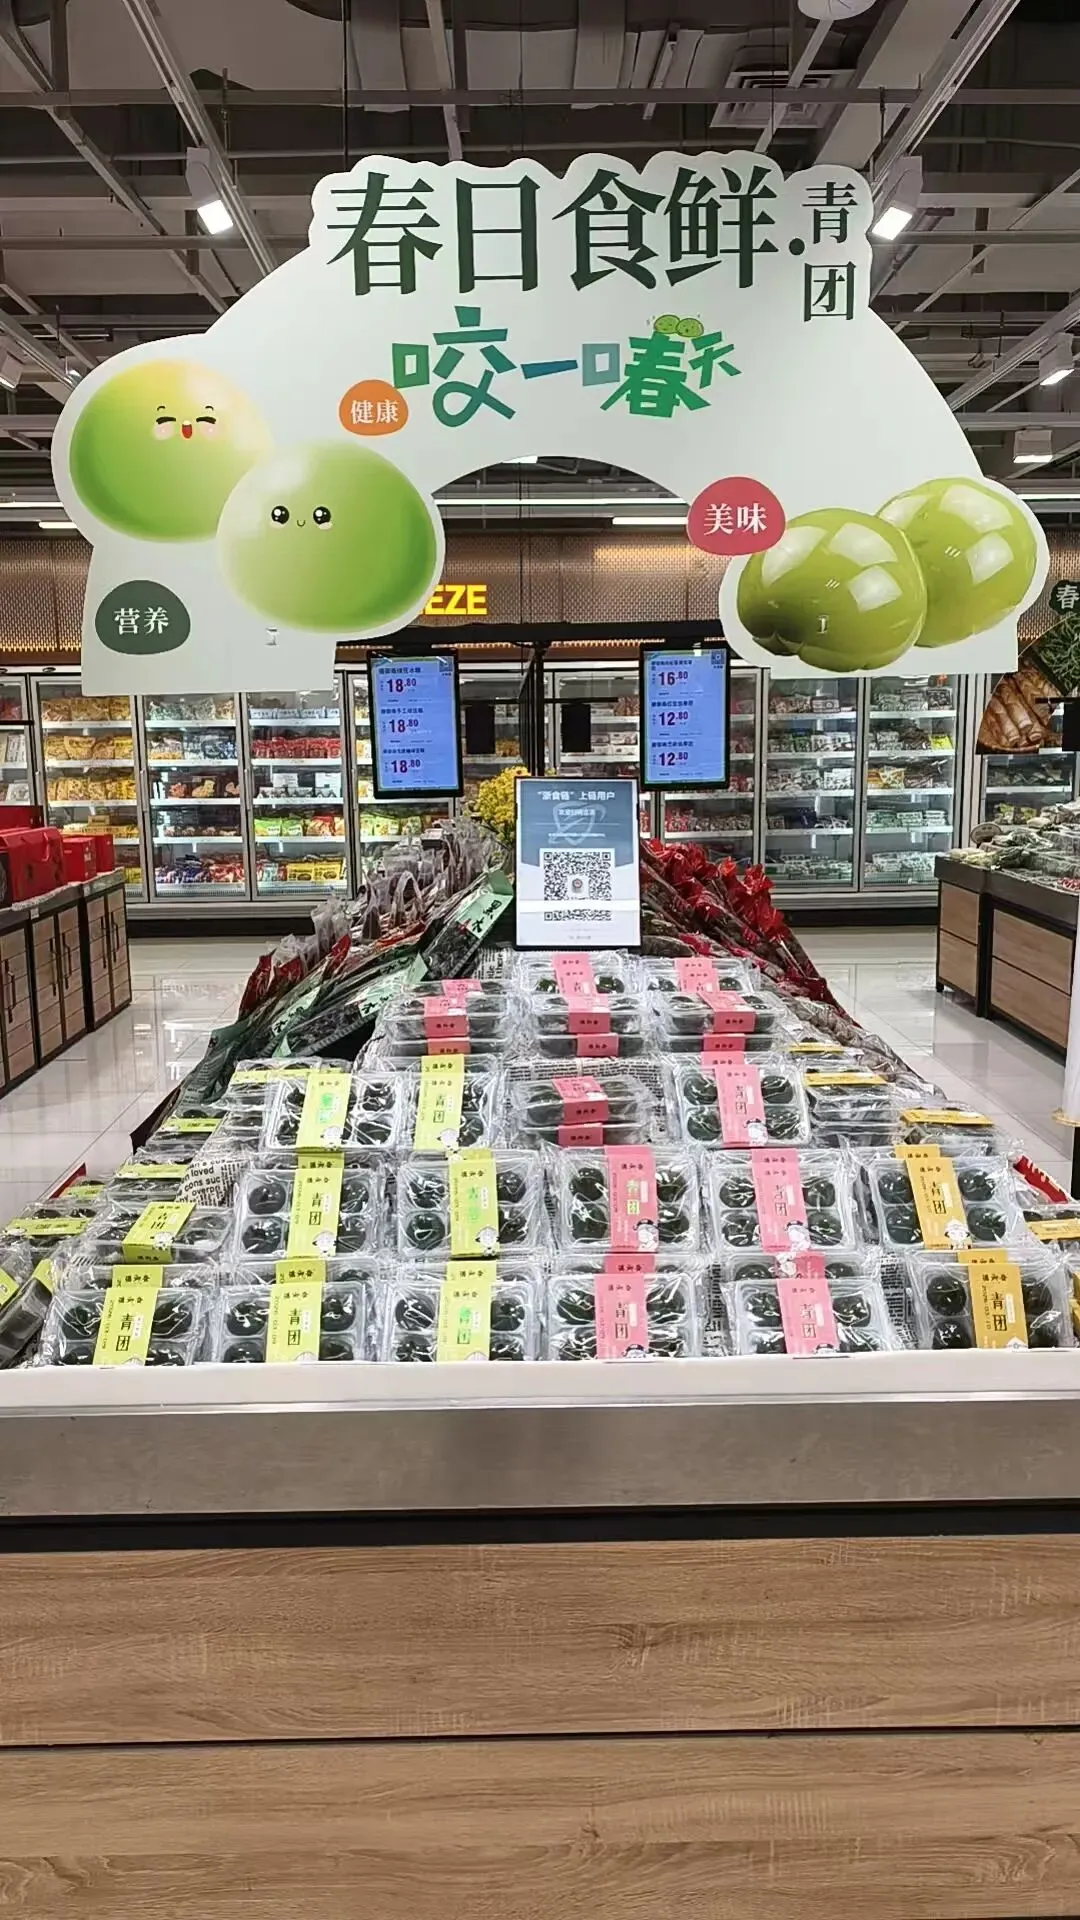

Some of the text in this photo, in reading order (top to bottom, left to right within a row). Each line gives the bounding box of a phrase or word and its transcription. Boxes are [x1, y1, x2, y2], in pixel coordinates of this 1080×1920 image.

[801, 182, 859, 322] 青团
[391, 305, 742, 428] 咬一口春天
[350, 400, 400, 424] 健康
[703, 503, 767, 536] 美味
[419, 584, 488, 615] EZE
[113, 608, 169, 635] 营养
[386, 678, 417, 693] 18.80
[658, 671, 689, 686] 16.80
[388, 719, 419, 733] 18.80
[659, 711, 689, 726] 12.80
[391, 759, 421, 774] 18.80
[659, 752, 689, 766] 12.80
